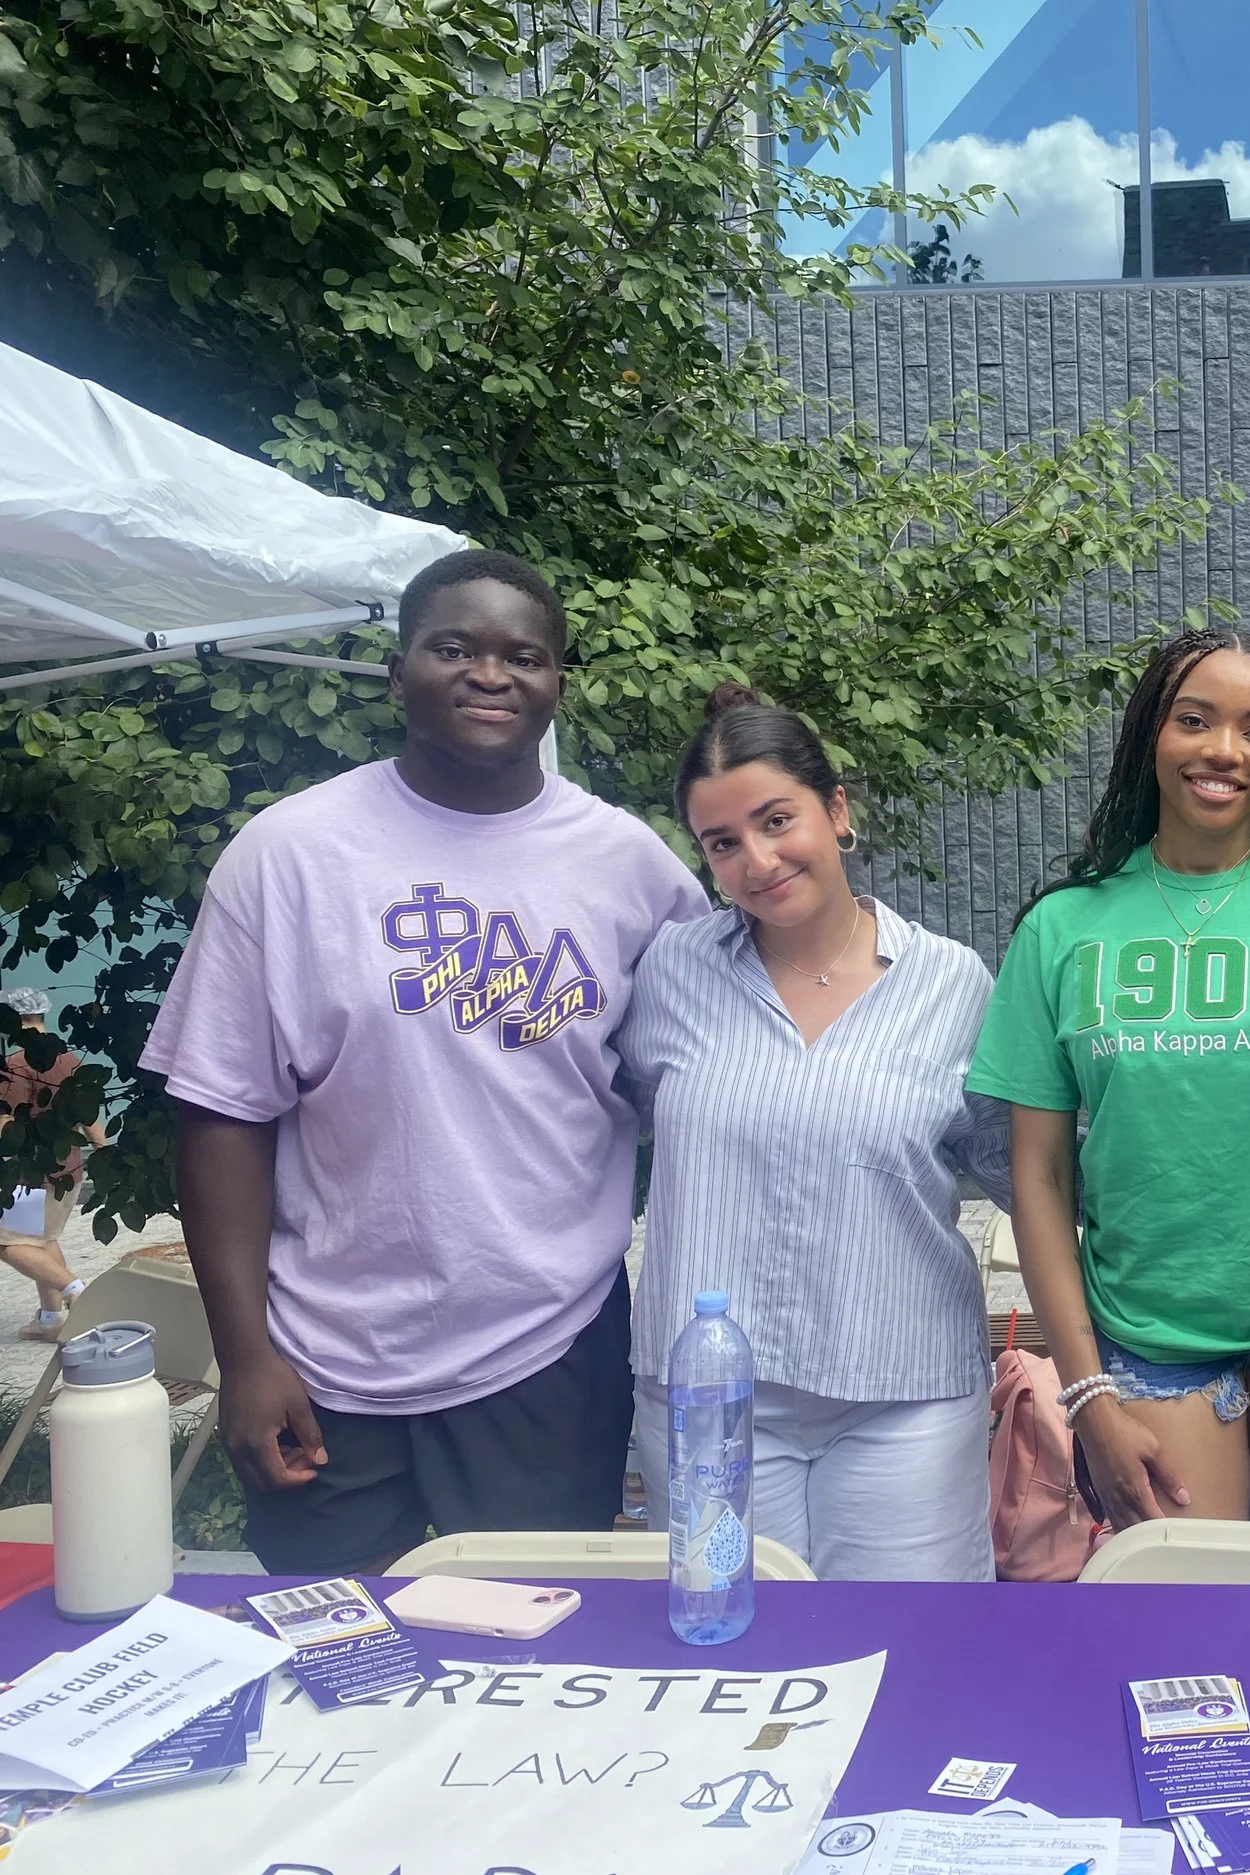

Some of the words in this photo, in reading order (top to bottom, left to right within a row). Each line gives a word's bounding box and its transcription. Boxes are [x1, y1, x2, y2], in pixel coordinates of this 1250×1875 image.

[422, 951, 461, 1004] PHI
[461, 964, 529, 1026] ALPHA
[518, 985, 585, 1043] DELTA
[1091, 1029, 1145, 1060] Alpha
[1153, 1030, 1227, 1057] Kappa
[62, 1661, 119, 1692] CLUB
[112, 1632, 169, 1662] FIELD
[291, 1642, 354, 1662] National
[78, 1669, 159, 1716] HOCKEY
[1141, 1739, 1207, 1756] National
[440, 1751, 670, 1787] LAW?
[937, 1778, 975, 1796] IT
[970, 1766, 1004, 1797] DEPENDS
